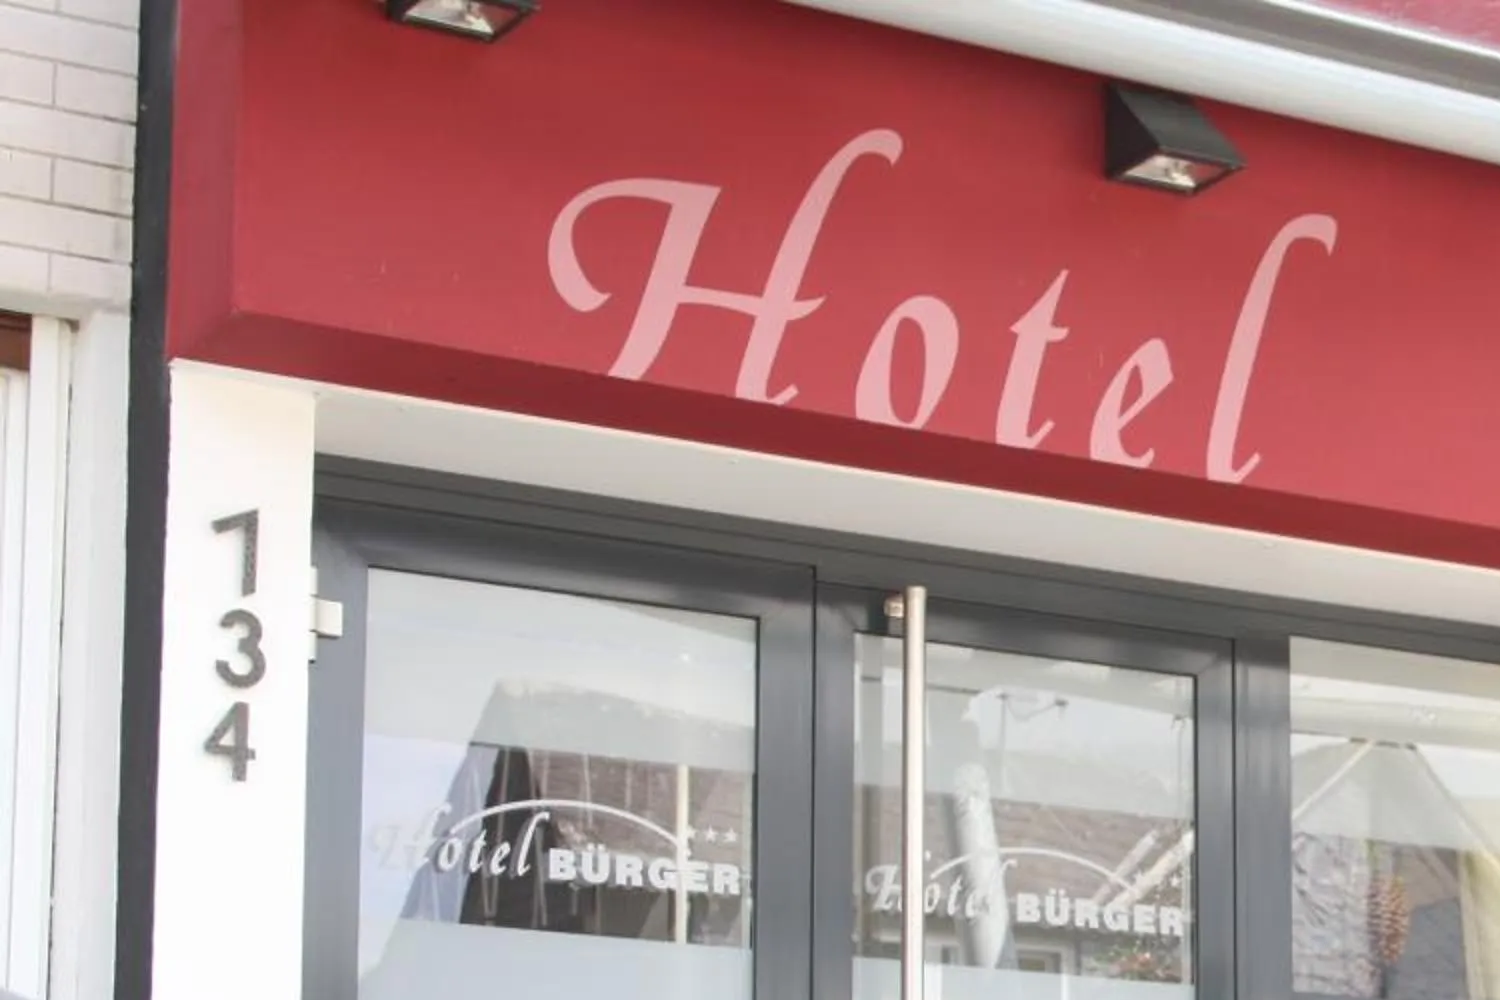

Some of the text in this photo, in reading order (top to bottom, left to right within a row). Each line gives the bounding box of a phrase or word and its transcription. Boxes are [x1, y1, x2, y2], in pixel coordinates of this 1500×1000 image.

[547, 127, 1338, 483] Hotel
[203, 508, 267, 783] 134
[372, 803, 741, 895] Hotel BÜRGER
[1016, 889, 1184, 936] BÜRGER
